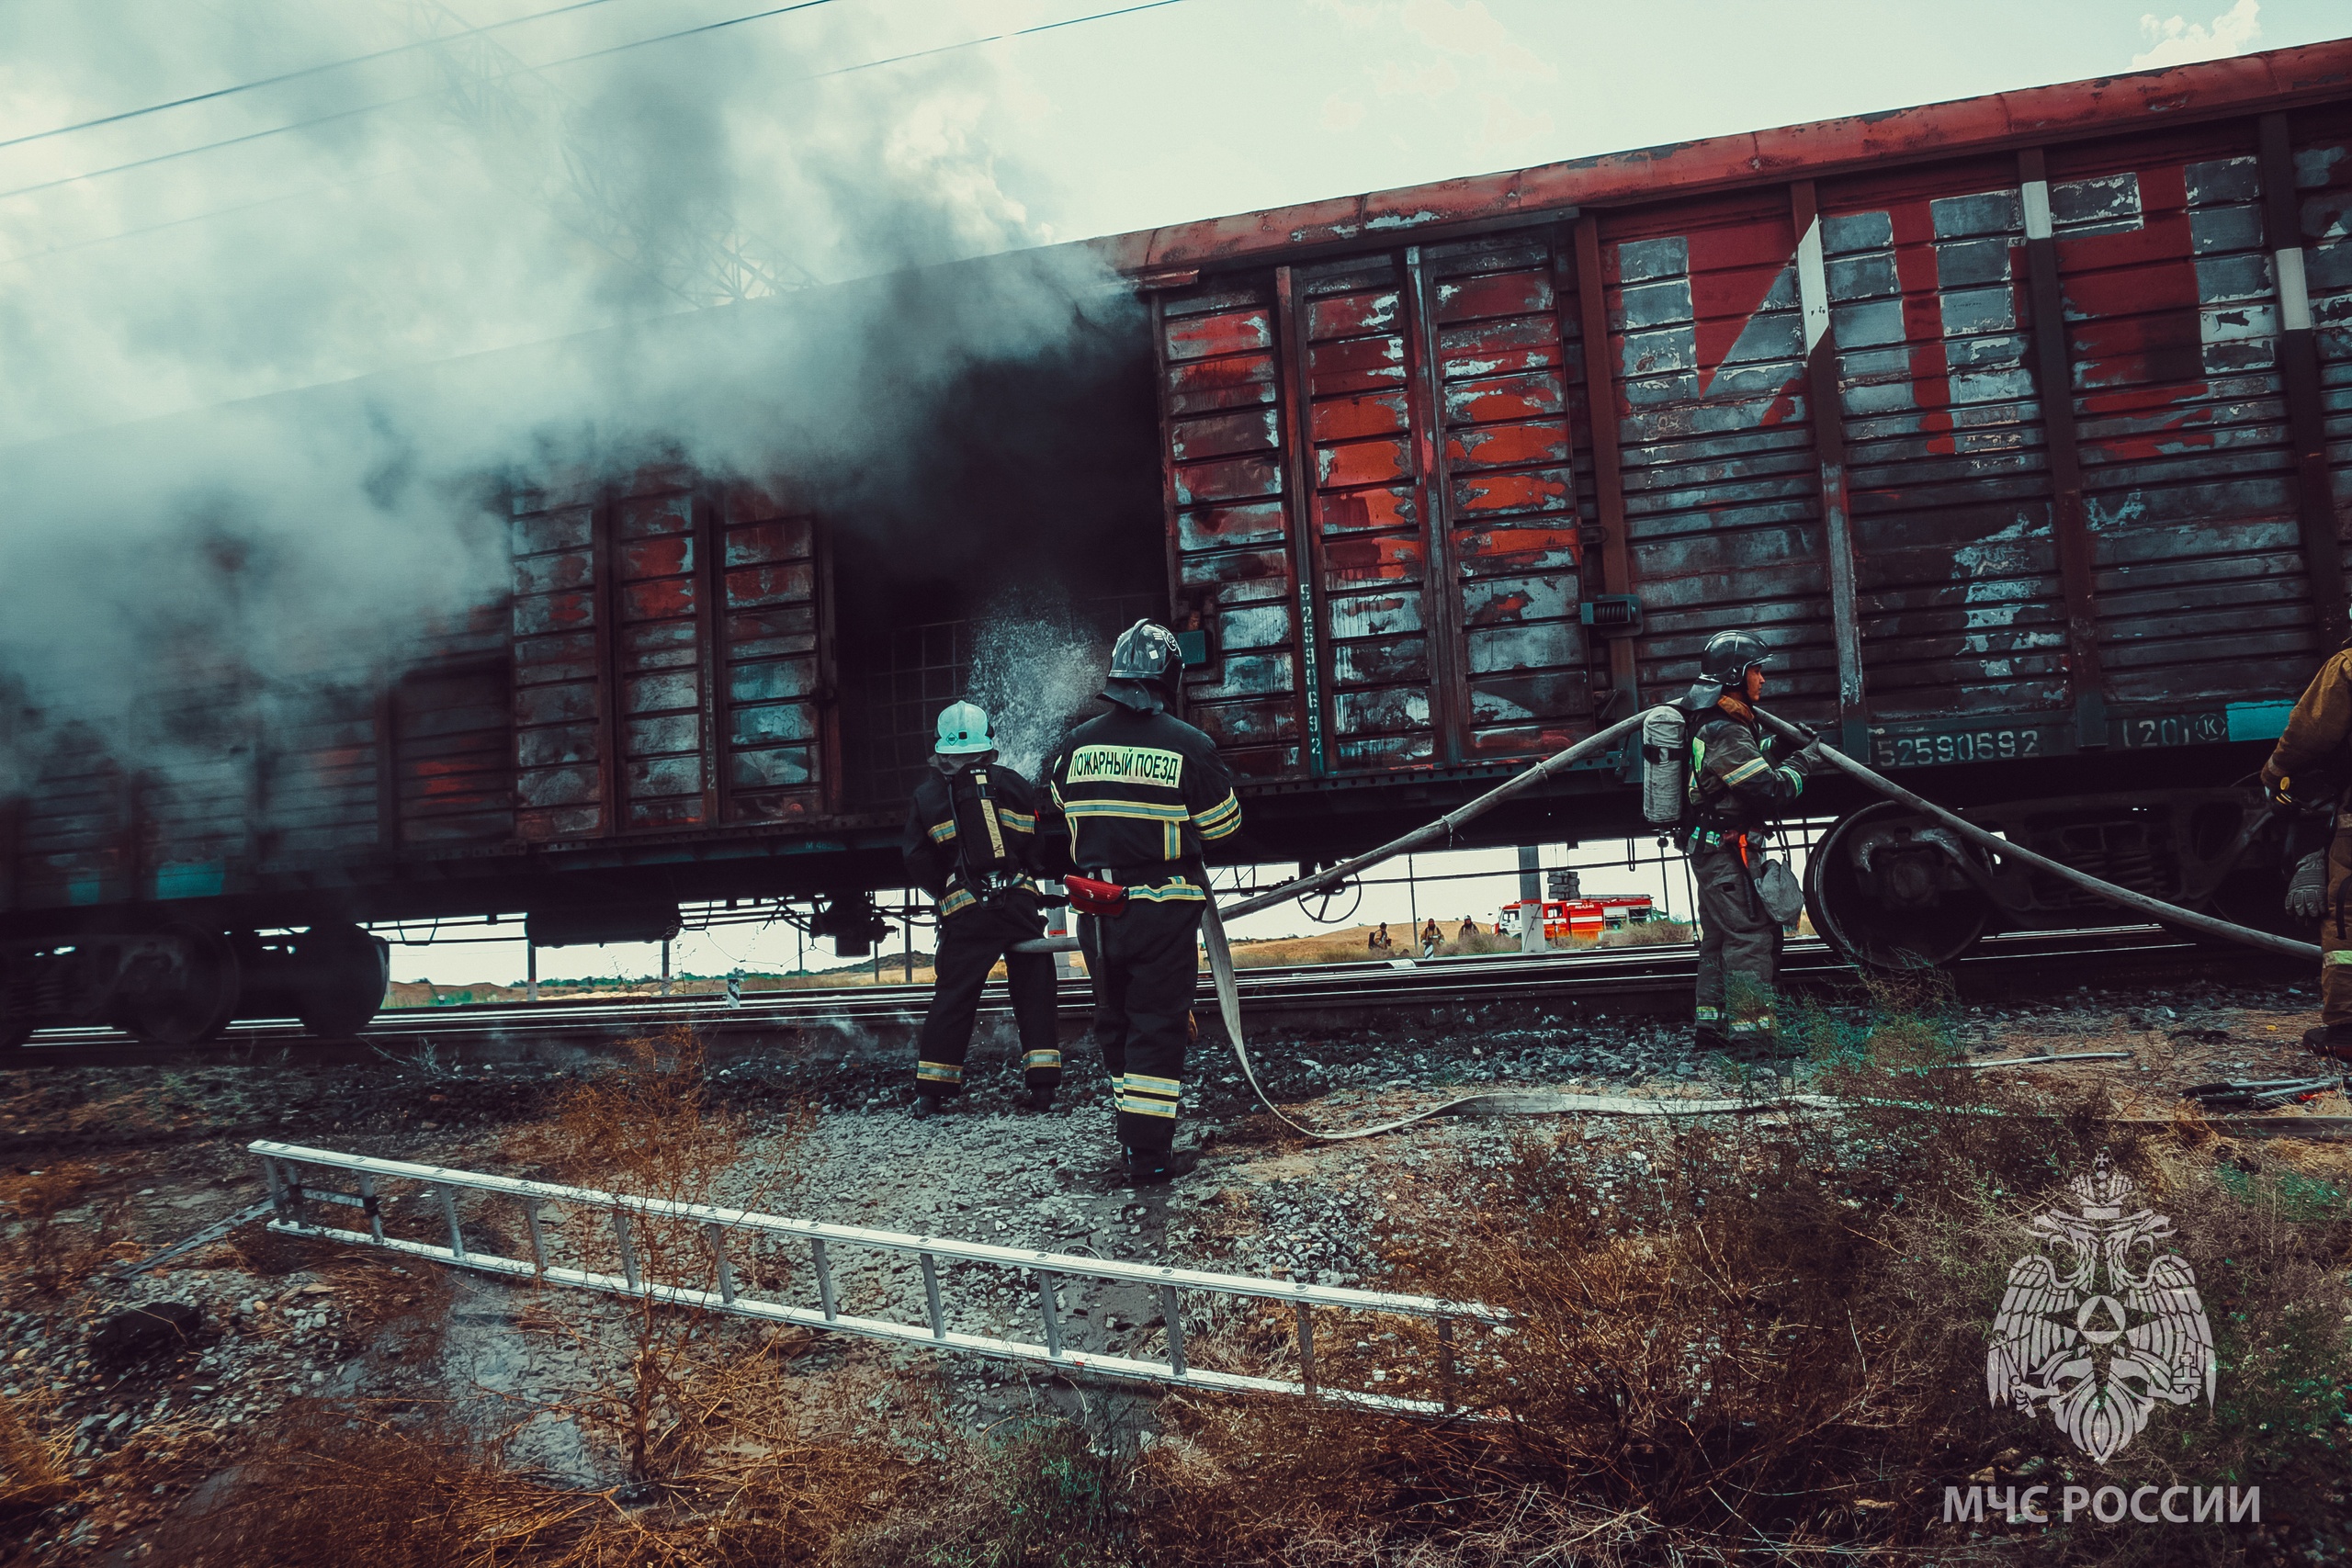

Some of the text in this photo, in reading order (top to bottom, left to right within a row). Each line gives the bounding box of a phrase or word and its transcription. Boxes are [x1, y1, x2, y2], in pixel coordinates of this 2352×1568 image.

[1878, 730, 2040, 766] 52590692
[1070, 748, 1179, 785] ПОЖАРНЫЙ ПОЕЗД
